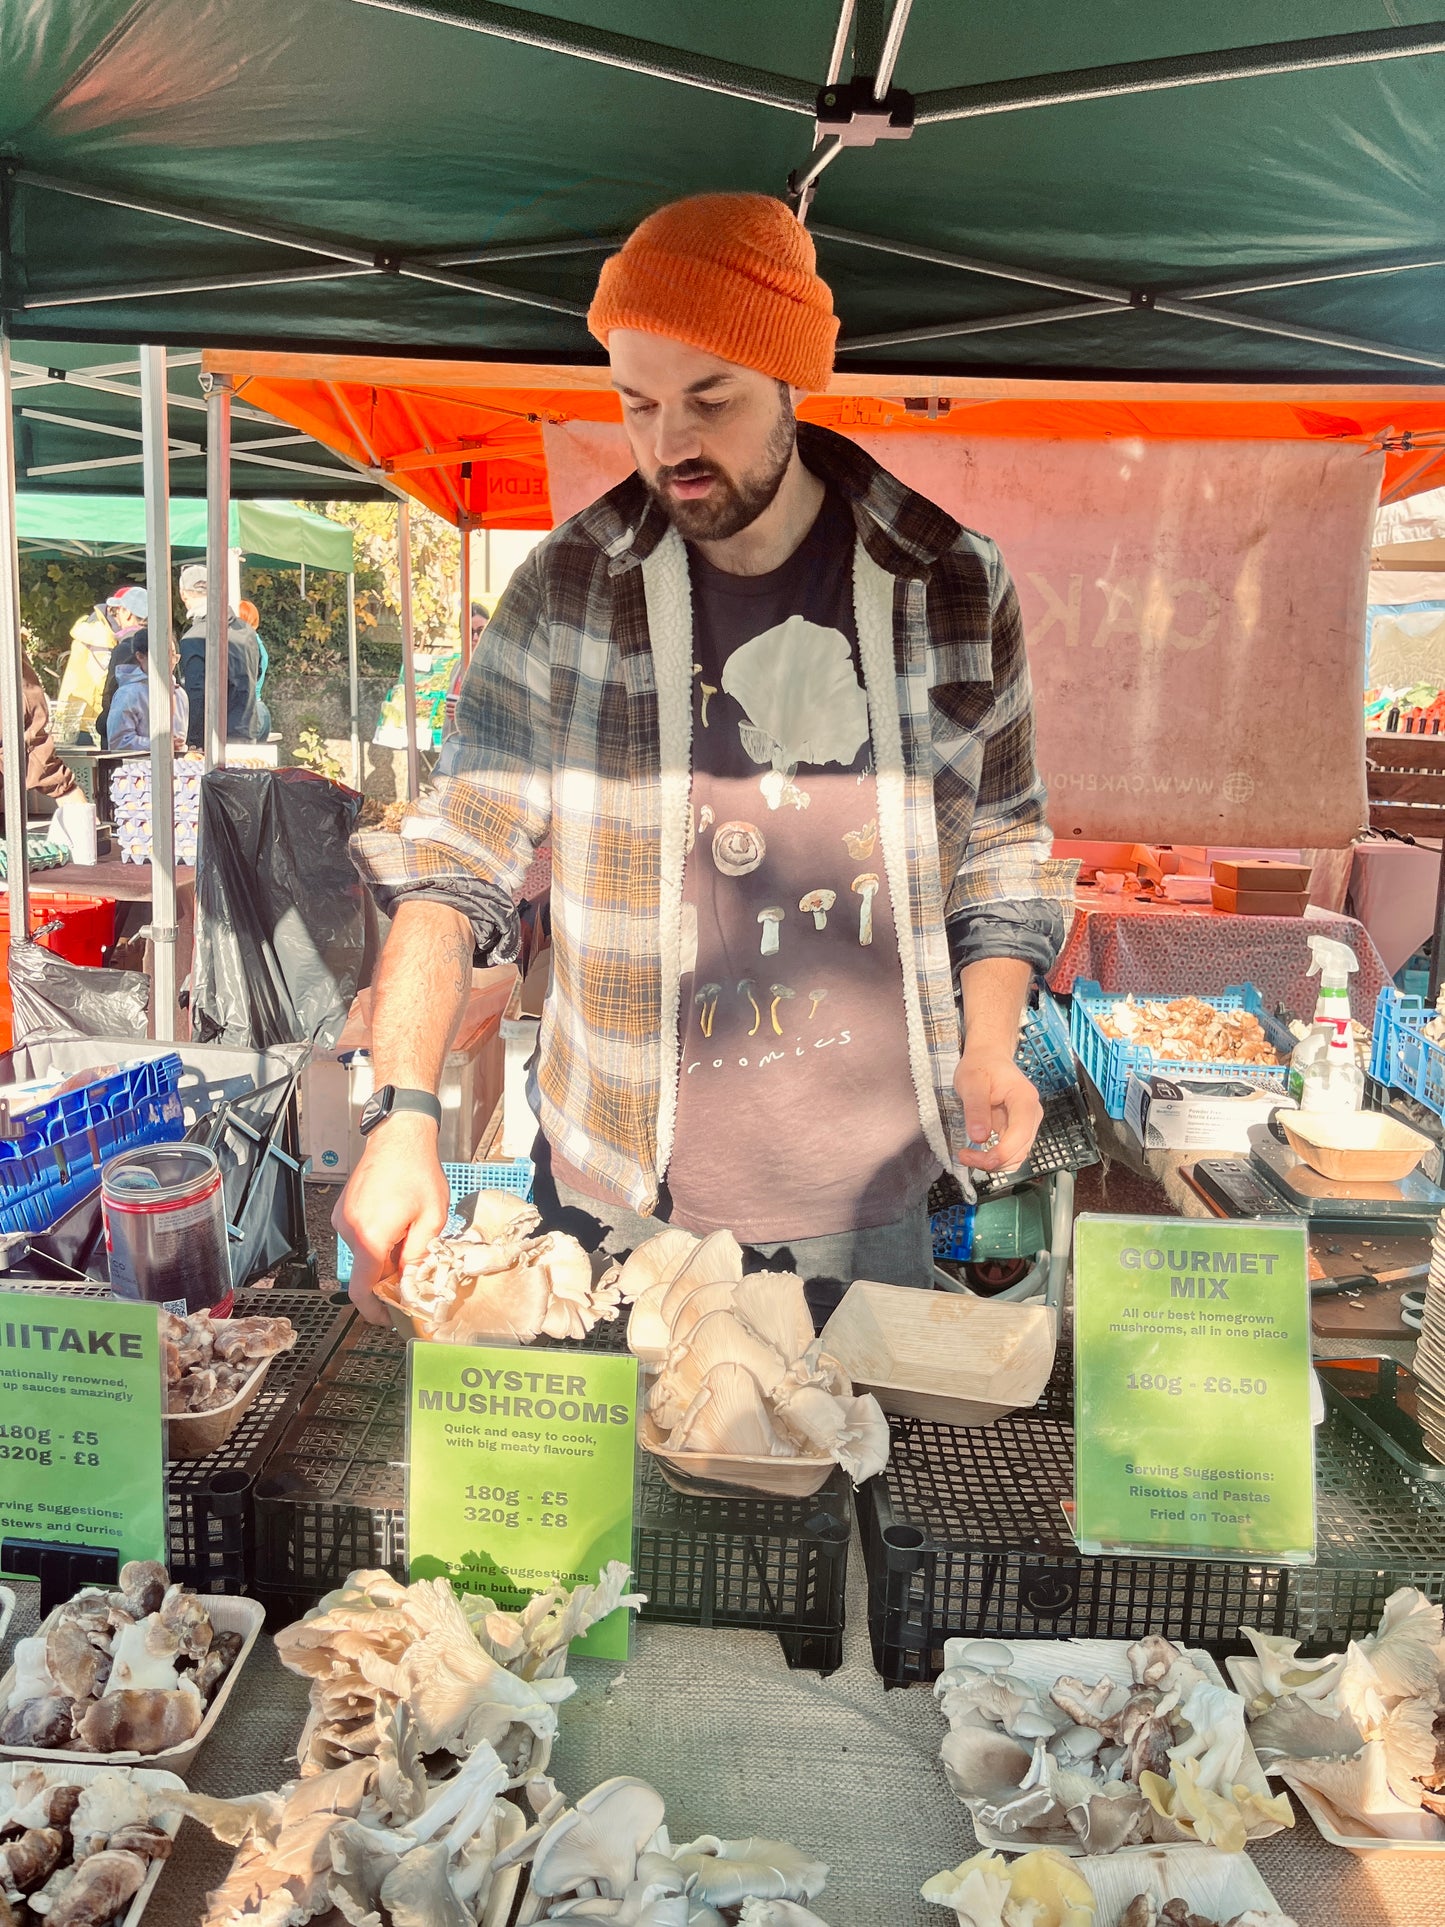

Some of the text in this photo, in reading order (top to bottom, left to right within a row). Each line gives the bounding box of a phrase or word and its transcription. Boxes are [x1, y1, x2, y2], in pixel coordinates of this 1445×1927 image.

[1119, 1248, 1279, 1275] GOURMET
[1170, 1277, 1230, 1300] MIX
[1122, 1308, 1275, 1325] All our best homegrown
[0, 1322, 144, 1360] IITAKE
[1109, 1323, 1288, 1340] mushrooms, all in one place
[62, 1373, 128, 1389] renowned,
[461, 1367, 587, 1397] OYSTER
[1126, 1373, 1182, 1396] 180g
[1203, 1376, 1268, 1395] £6.50
[3, 1382, 134, 1402] up sauces amazingly
[418, 1389, 629, 1426] MUSHROOMS
[0, 1424, 51, 1445] 180g
[72, 1430, 99, 1446] £5
[444, 1423, 597, 1446] Quick and easy to cook,
[0, 1445, 53, 1466] 320g
[74, 1451, 100, 1467] £8
[446, 1437, 594, 1457] with big meaty flavours
[1125, 1463, 1275, 1481] Serving Suggestions:
[464, 1485, 520, 1507] 180g
[541, 1491, 568, 1506] £5
[1129, 1486, 1271, 1503] Risottos and Pastas
[38, 1503, 123, 1519] Suggestions:
[463, 1506, 520, 1528] 320g
[540, 1512, 568, 1528] £8
[1150, 1509, 1251, 1524] Fried on Toast
[1, 1518, 123, 1537] Stews and Curries
[445, 1561, 589, 1582] Serving Suggestions:
[450, 1580, 470, 1590] ied
[474, 1581, 487, 1591] in
[490, 1581, 531, 1595] butter
